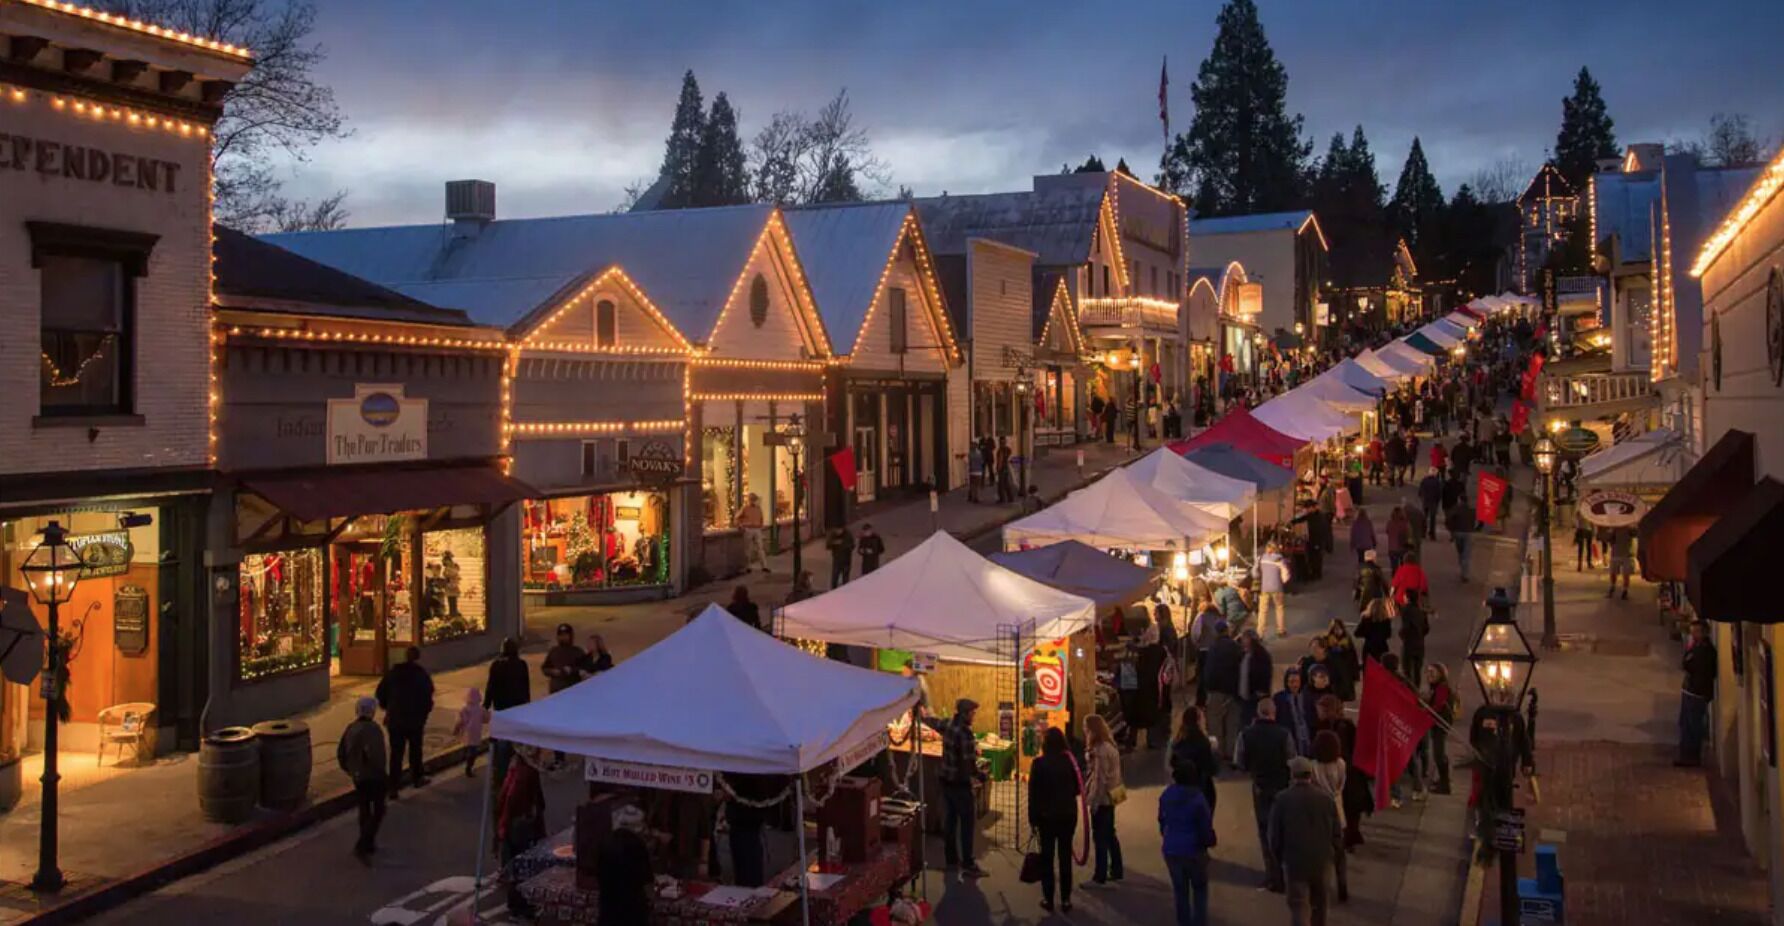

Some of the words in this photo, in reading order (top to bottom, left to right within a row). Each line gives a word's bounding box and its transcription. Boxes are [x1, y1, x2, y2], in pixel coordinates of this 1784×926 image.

[335, 433, 355, 458] The
[381, 432, 422, 455] Traders
[631, 458, 680, 473] NOVAK'S
